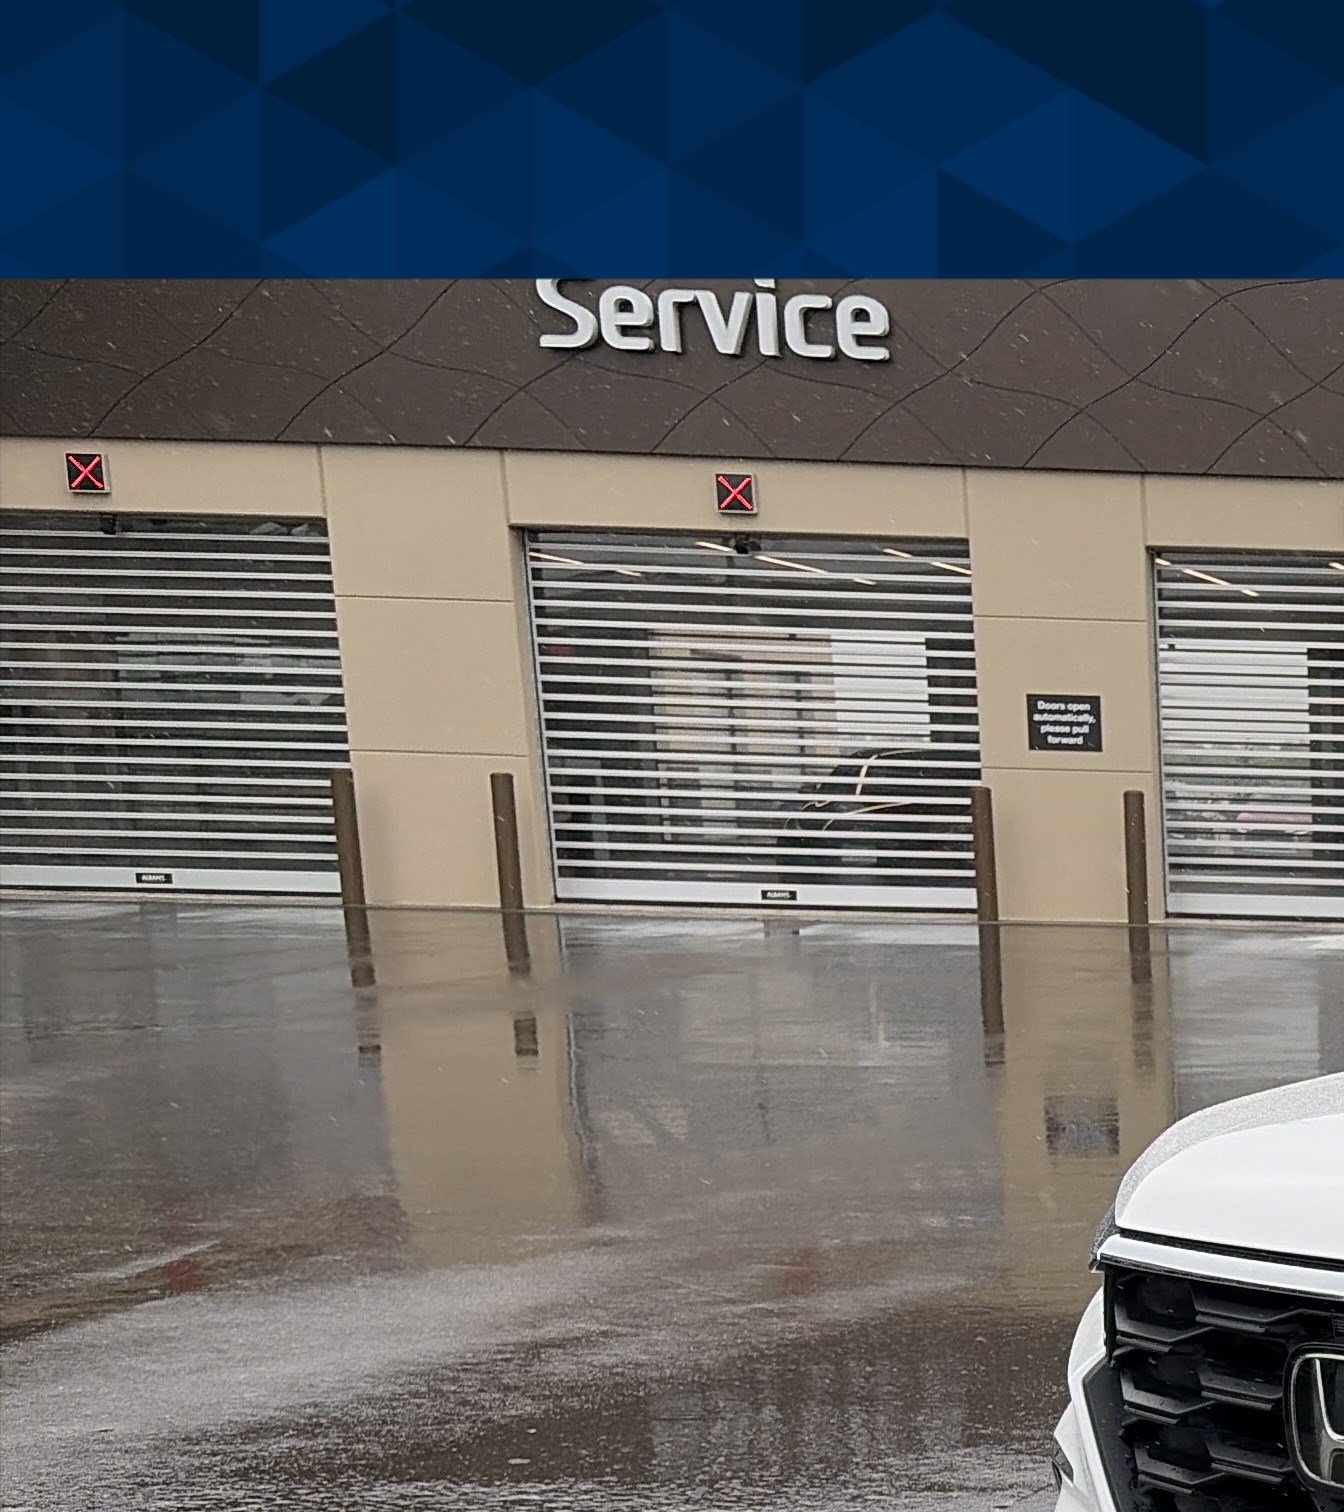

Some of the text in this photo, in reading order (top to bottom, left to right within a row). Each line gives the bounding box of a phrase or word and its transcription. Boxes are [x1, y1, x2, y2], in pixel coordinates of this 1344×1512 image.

[535, 278, 892, 360] Service
[1037, 700, 1091, 712] Doors open
[1040, 724, 1089, 735] please pull
[1047, 735, 1084, 745] forward
